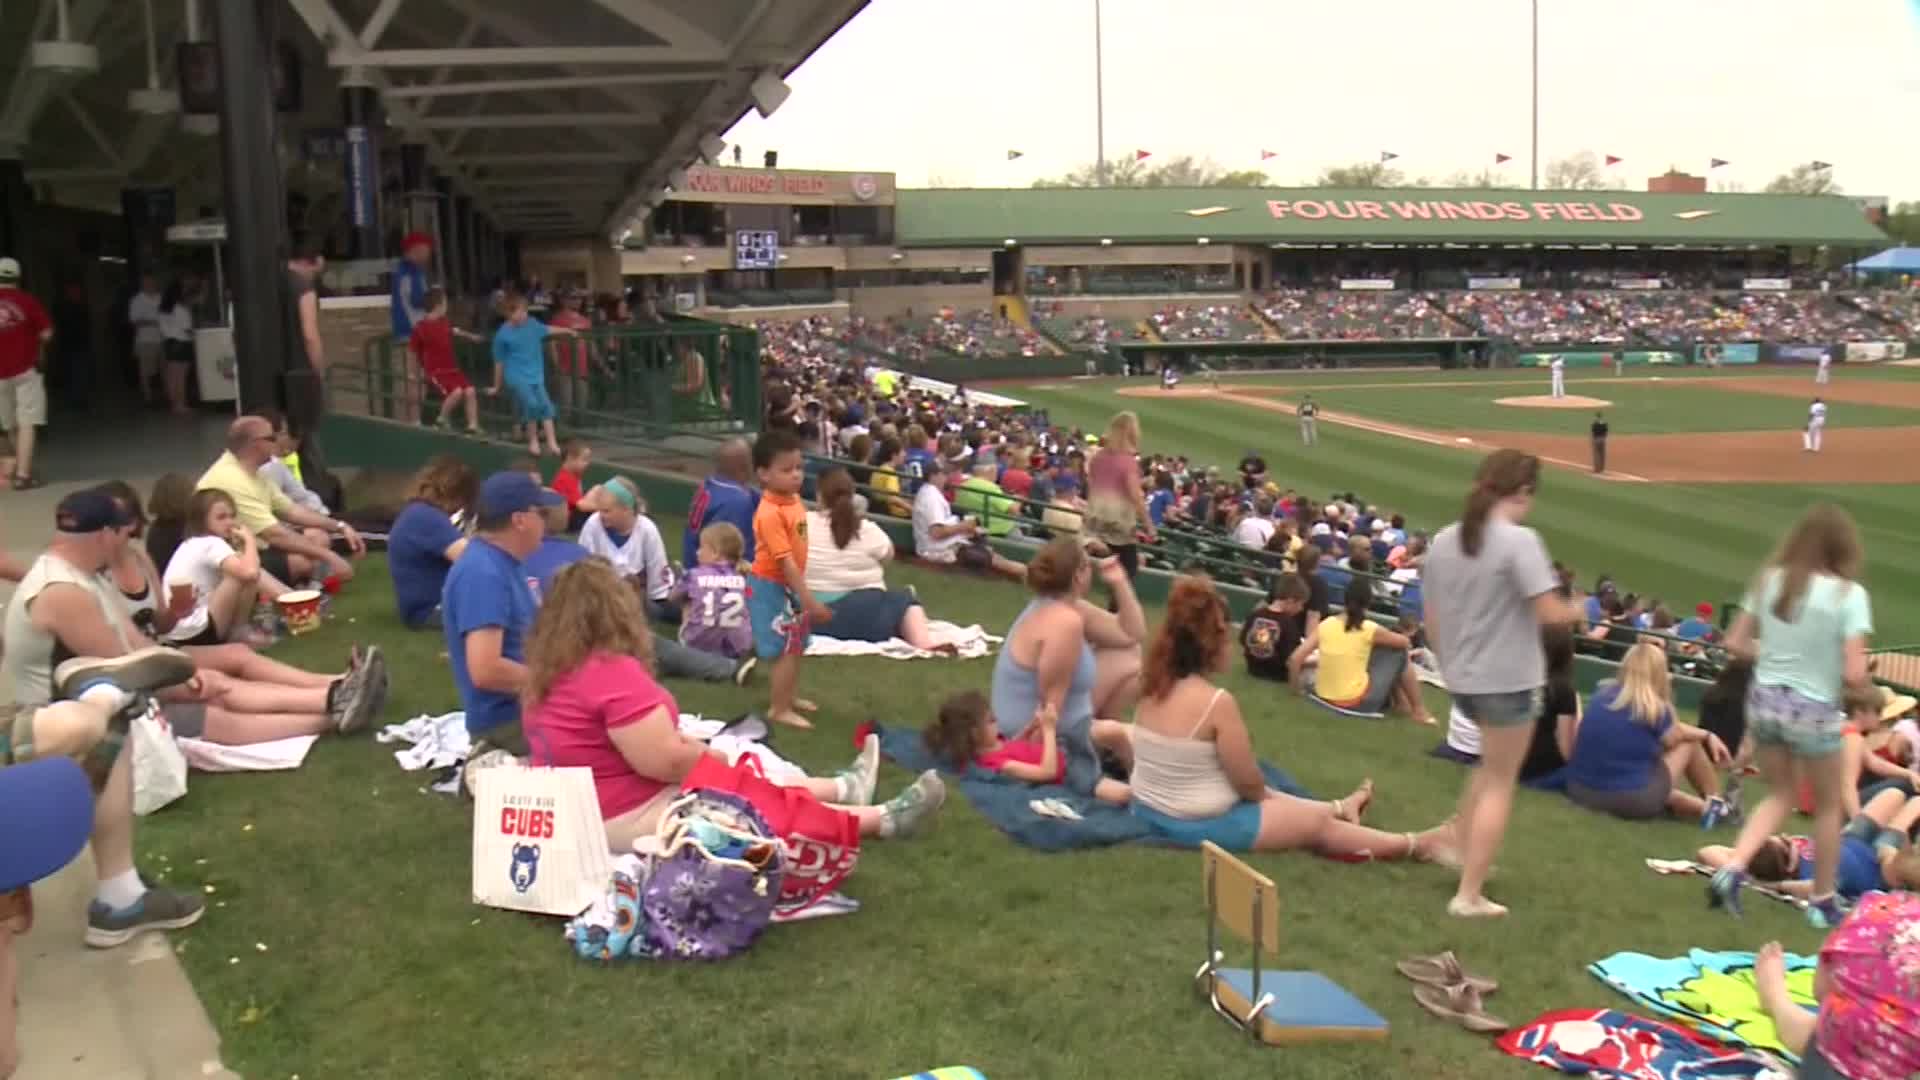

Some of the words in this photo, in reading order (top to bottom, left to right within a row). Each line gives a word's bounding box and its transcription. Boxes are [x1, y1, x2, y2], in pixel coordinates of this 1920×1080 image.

[783, 176, 825, 194] FIELD
[1267, 199, 1389, 220] FOUR
[1388, 201, 1532, 221] WINDS
[1531, 202, 1643, 222] FIELD
[702, 591, 744, 628] 12
[500, 807, 555, 838] CUBS
